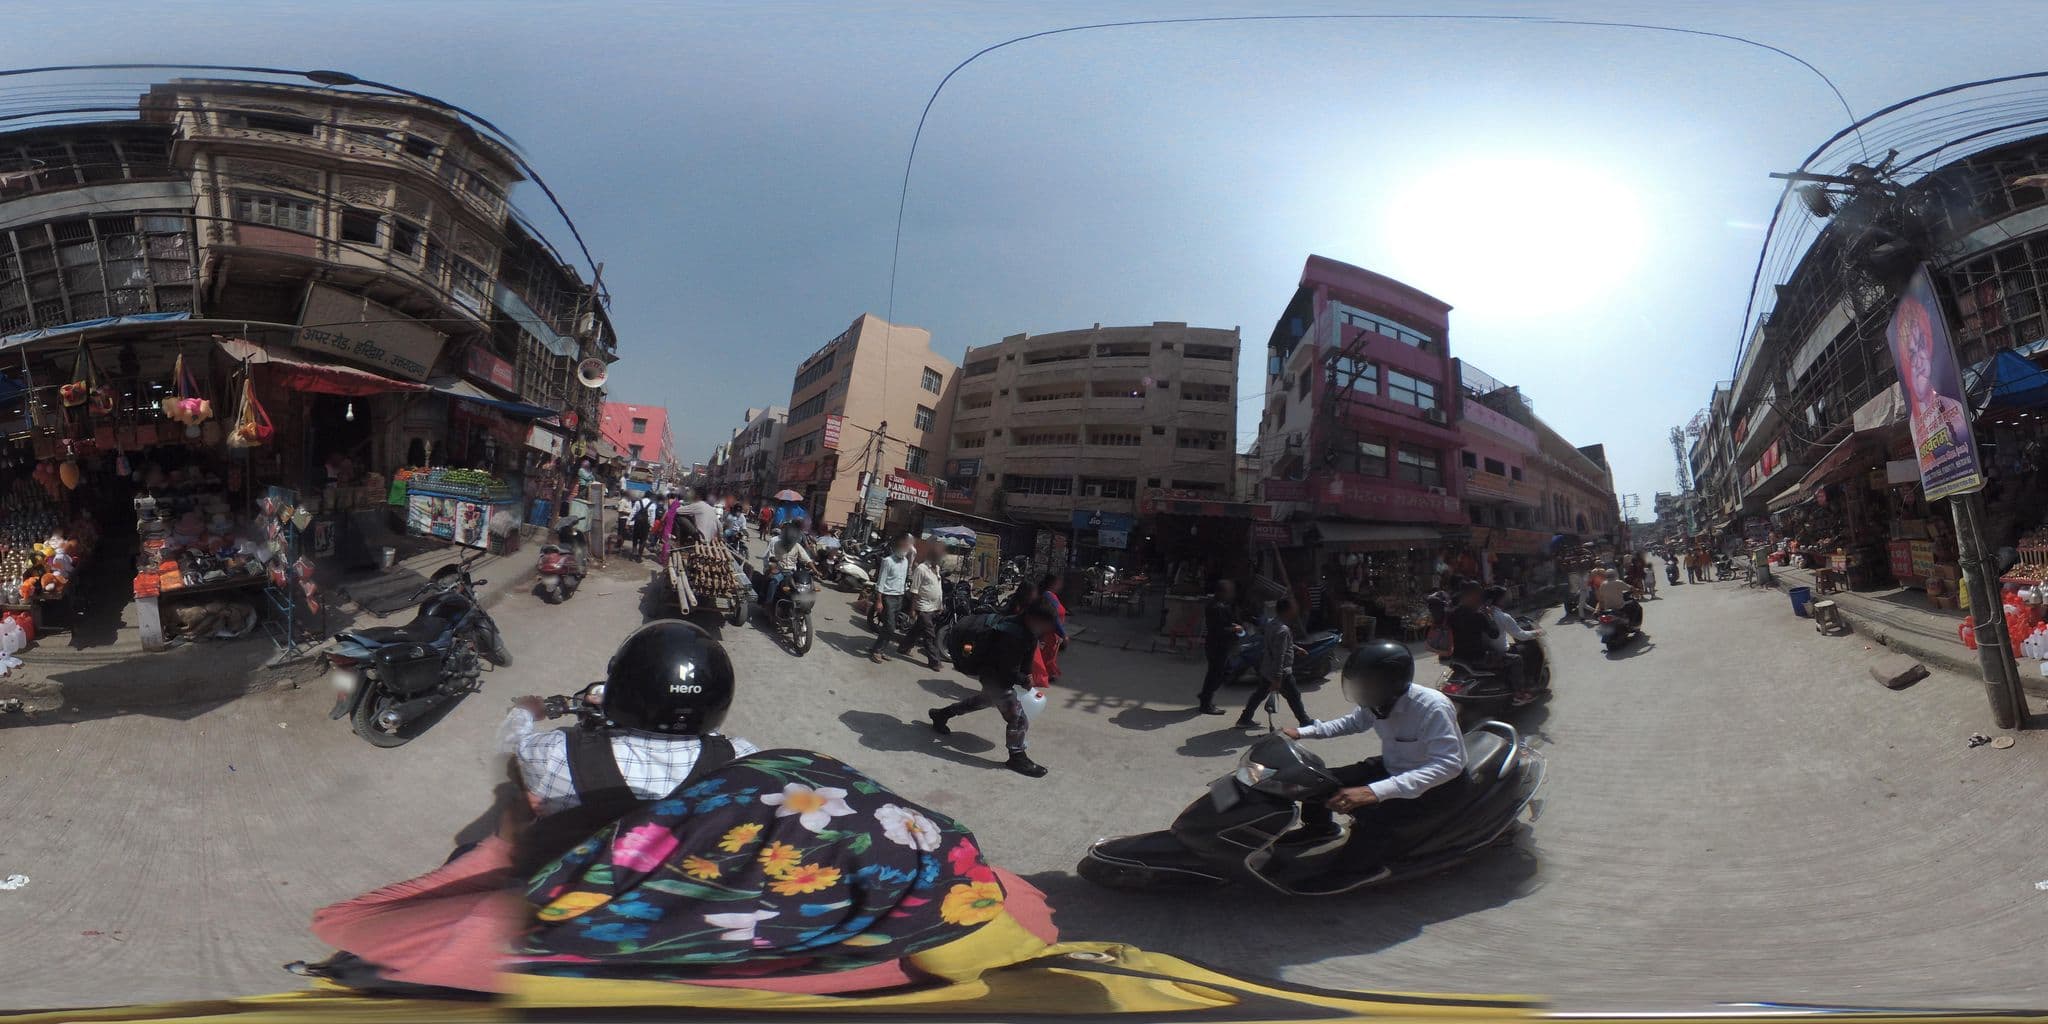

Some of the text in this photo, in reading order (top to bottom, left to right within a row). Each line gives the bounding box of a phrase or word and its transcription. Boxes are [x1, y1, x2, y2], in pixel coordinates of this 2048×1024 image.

[302, 328, 331, 345] अपर
[1089, 516, 1101, 525] Jio
[670, 684, 702, 694] Hero
